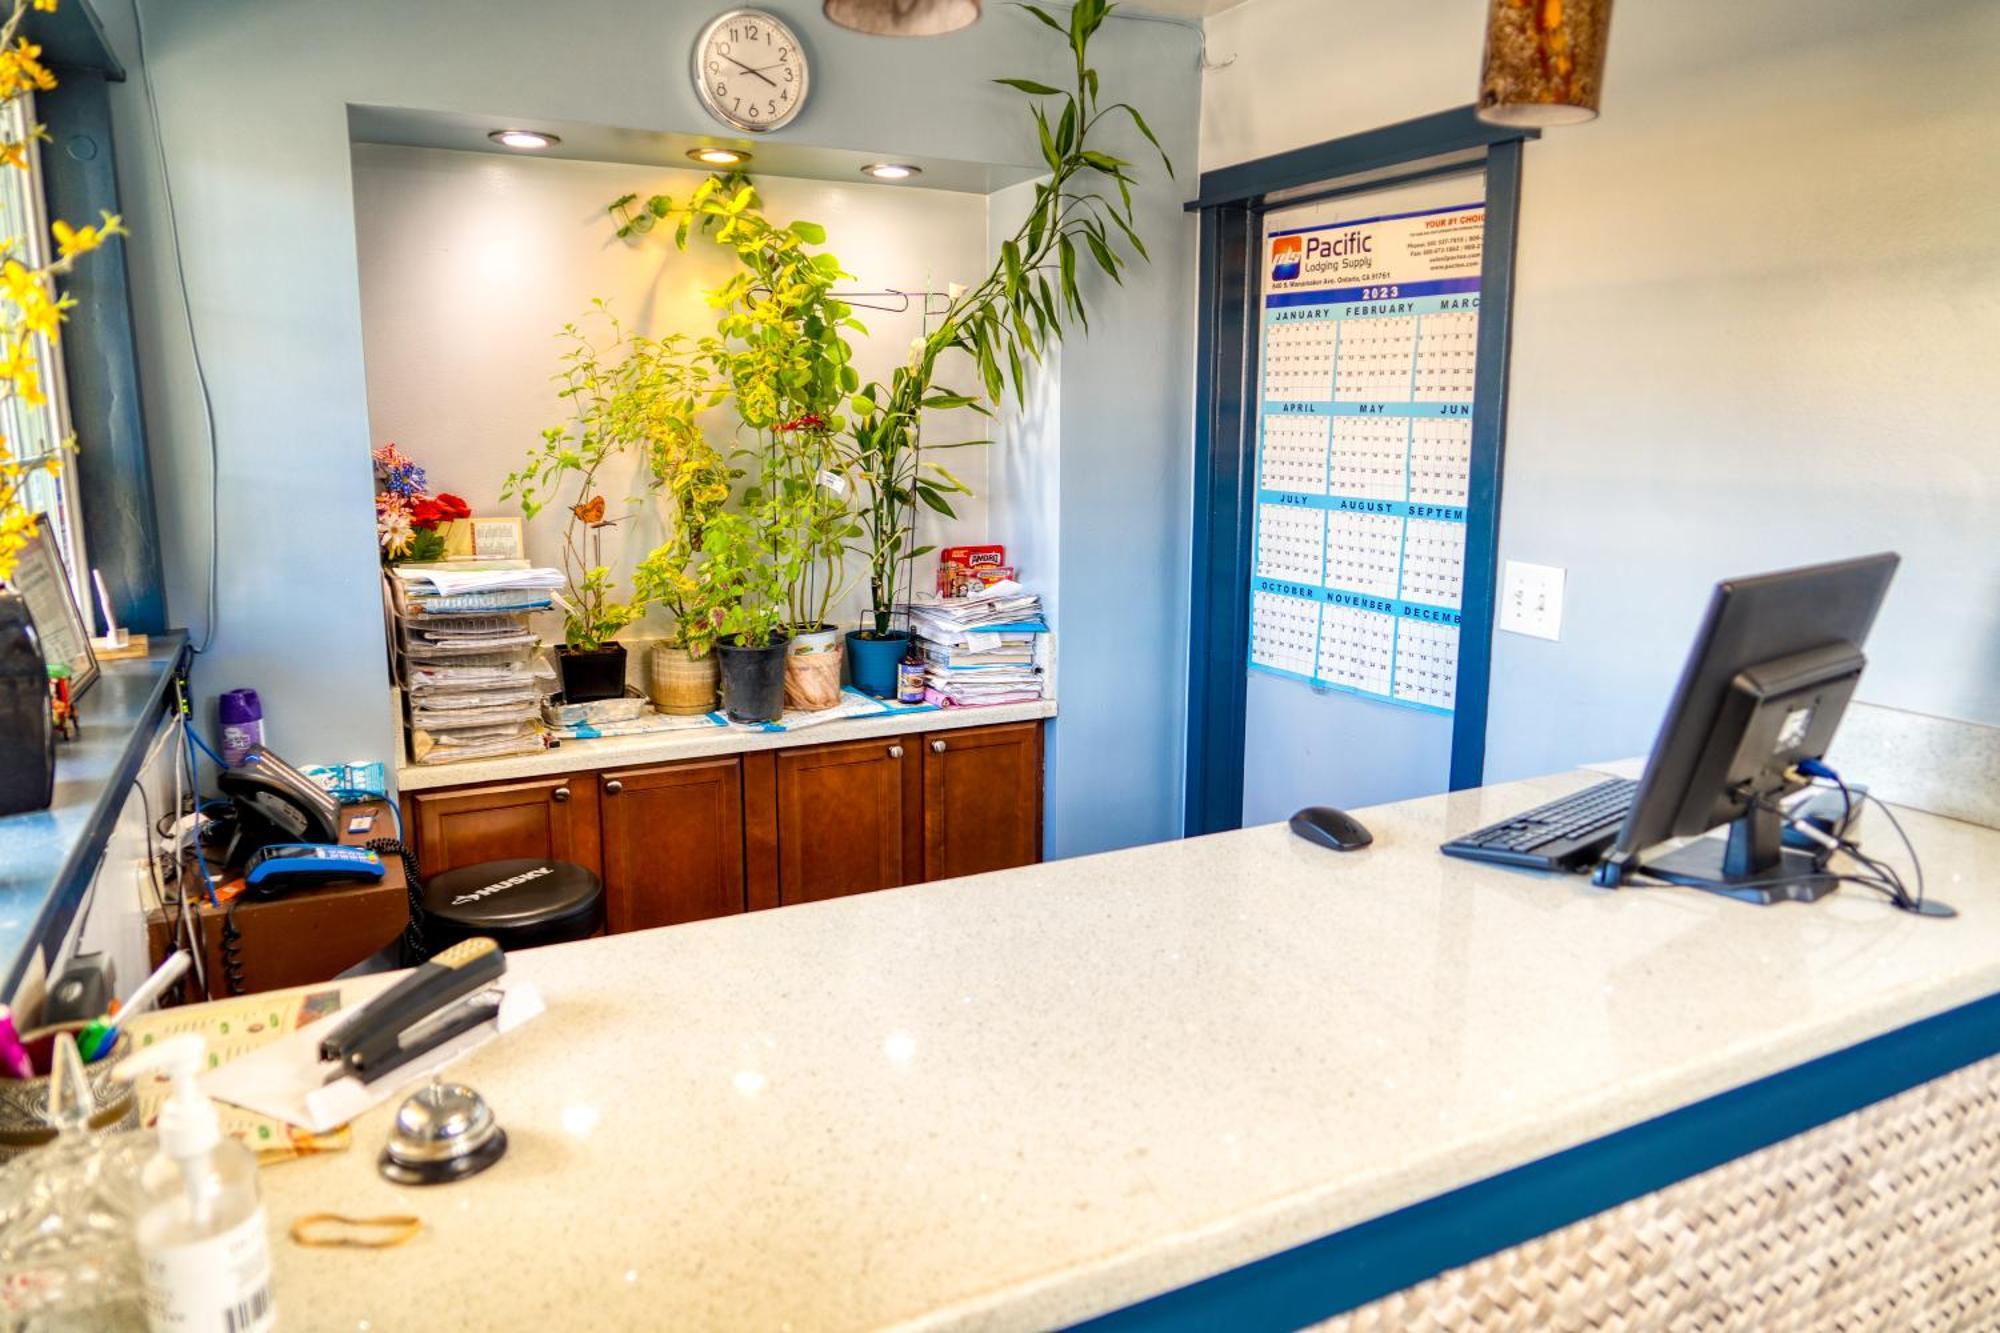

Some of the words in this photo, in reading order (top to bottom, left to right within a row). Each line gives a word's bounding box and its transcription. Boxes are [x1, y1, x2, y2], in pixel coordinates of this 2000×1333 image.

[729, 28, 738, 42] 11
[744, 25, 758, 40] 12
[766, 32, 771, 46] 1
[715, 42, 730, 56] 10
[778, 47, 788, 62] 2
[708, 61, 720, 75] 9
[785, 67, 794, 82] 3
[716, 82, 727, 96] 8
[780, 88, 788, 102] 4
[734, 97, 741, 112] 7
[748, 104, 759, 118] 6
[768, 100, 776, 114] 5
[1426, 219, 1446, 228] YOUR
[1306, 231, 1372, 260] Pacific
[1305, 261, 1339, 272] Lodging
[1342, 256, 1372, 270] Supply
[1362, 286, 1399, 300] 2023
[1276, 308, 1330, 320] JANUARY
[1346, 303, 1414, 316] FEBRUARY
[1283, 403, 1315, 412] APRIL
[1360, 404, 1384, 413] MAY
[1440, 404, 1469, 414] JUN
[1280, 494, 1308, 504] JULY
[1340, 500, 1392, 512] AUGUST
[1408, 506, 1463, 519] SEPTEM
[1262, 581, 1313, 597] OCTOBER
[474, 867, 554, 896] HUSKY
